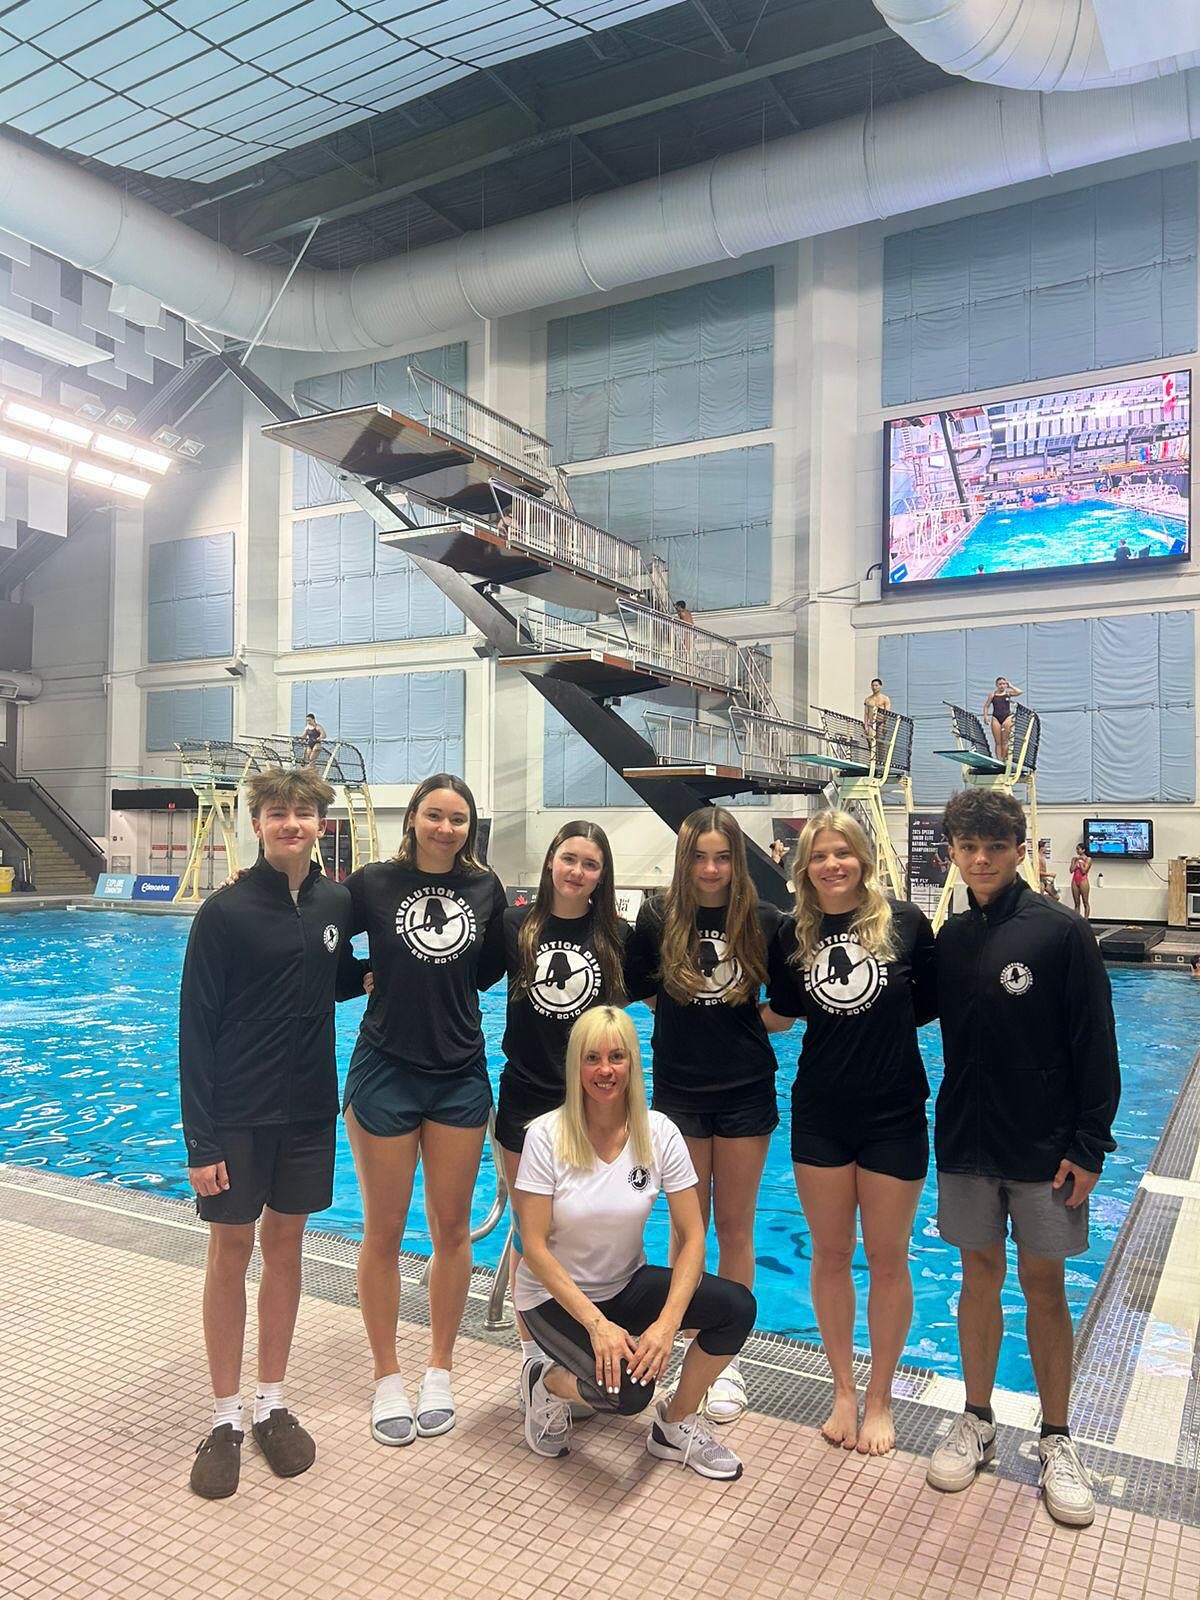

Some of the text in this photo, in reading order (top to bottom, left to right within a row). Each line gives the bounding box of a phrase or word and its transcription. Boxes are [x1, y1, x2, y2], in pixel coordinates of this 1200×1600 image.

[141, 882, 170, 893] Edmonton
[395, 887, 477, 941] REVOLUTION DIVING
[411, 949, 459, 964] EST. 2010
[583, 950, 602, 996] DIVING
[533, 1004, 581, 1020] EST. 2010
[821, 1002, 872, 1016] EST. 2010
